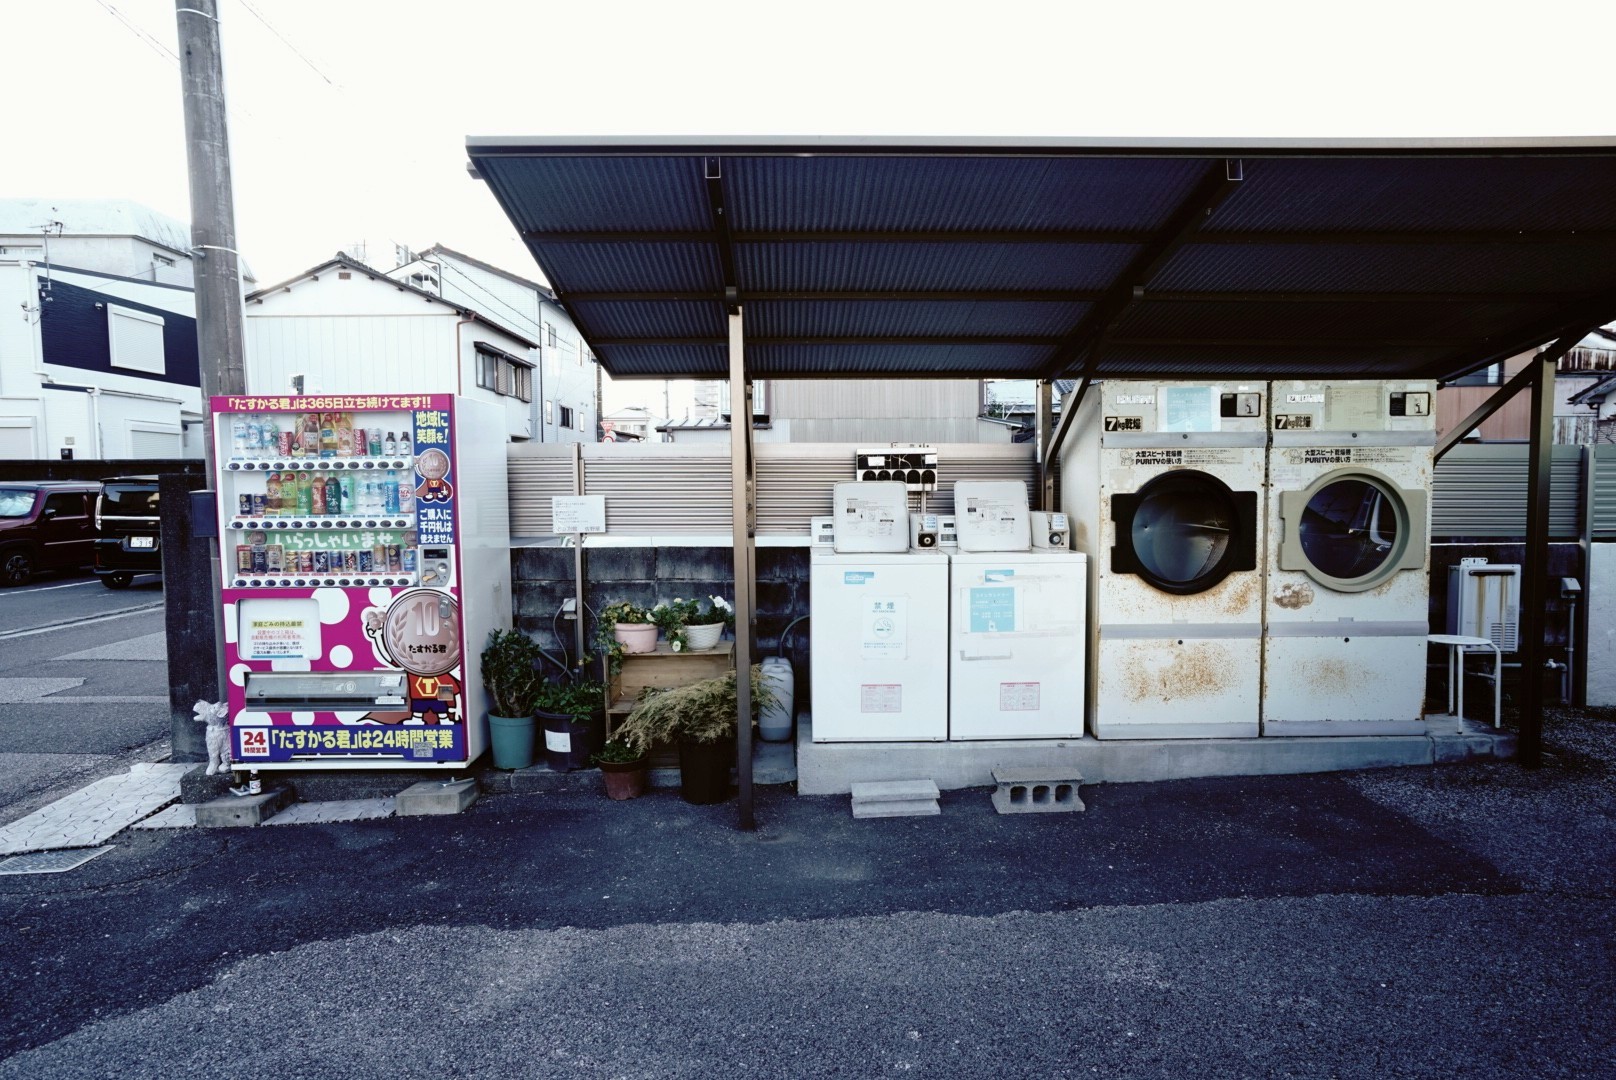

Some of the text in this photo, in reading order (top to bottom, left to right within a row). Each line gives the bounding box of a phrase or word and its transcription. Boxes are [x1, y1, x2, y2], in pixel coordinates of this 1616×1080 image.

[416, 411, 449, 427] 地域に
[417, 428, 449, 444] 笑顔を!
[420, 508, 452, 520] ご購入に
[420, 521, 452, 533] 千円札は
[275, 531, 394, 549] いらっしゃいませ
[420, 534, 453, 544] 使えません
[411, 601, 440, 636] 10
[408, 643, 447, 654] たすかる君
[243, 731, 266, 746] 24
[272, 729, 453, 749] 「たすかる君」は24時間営業
